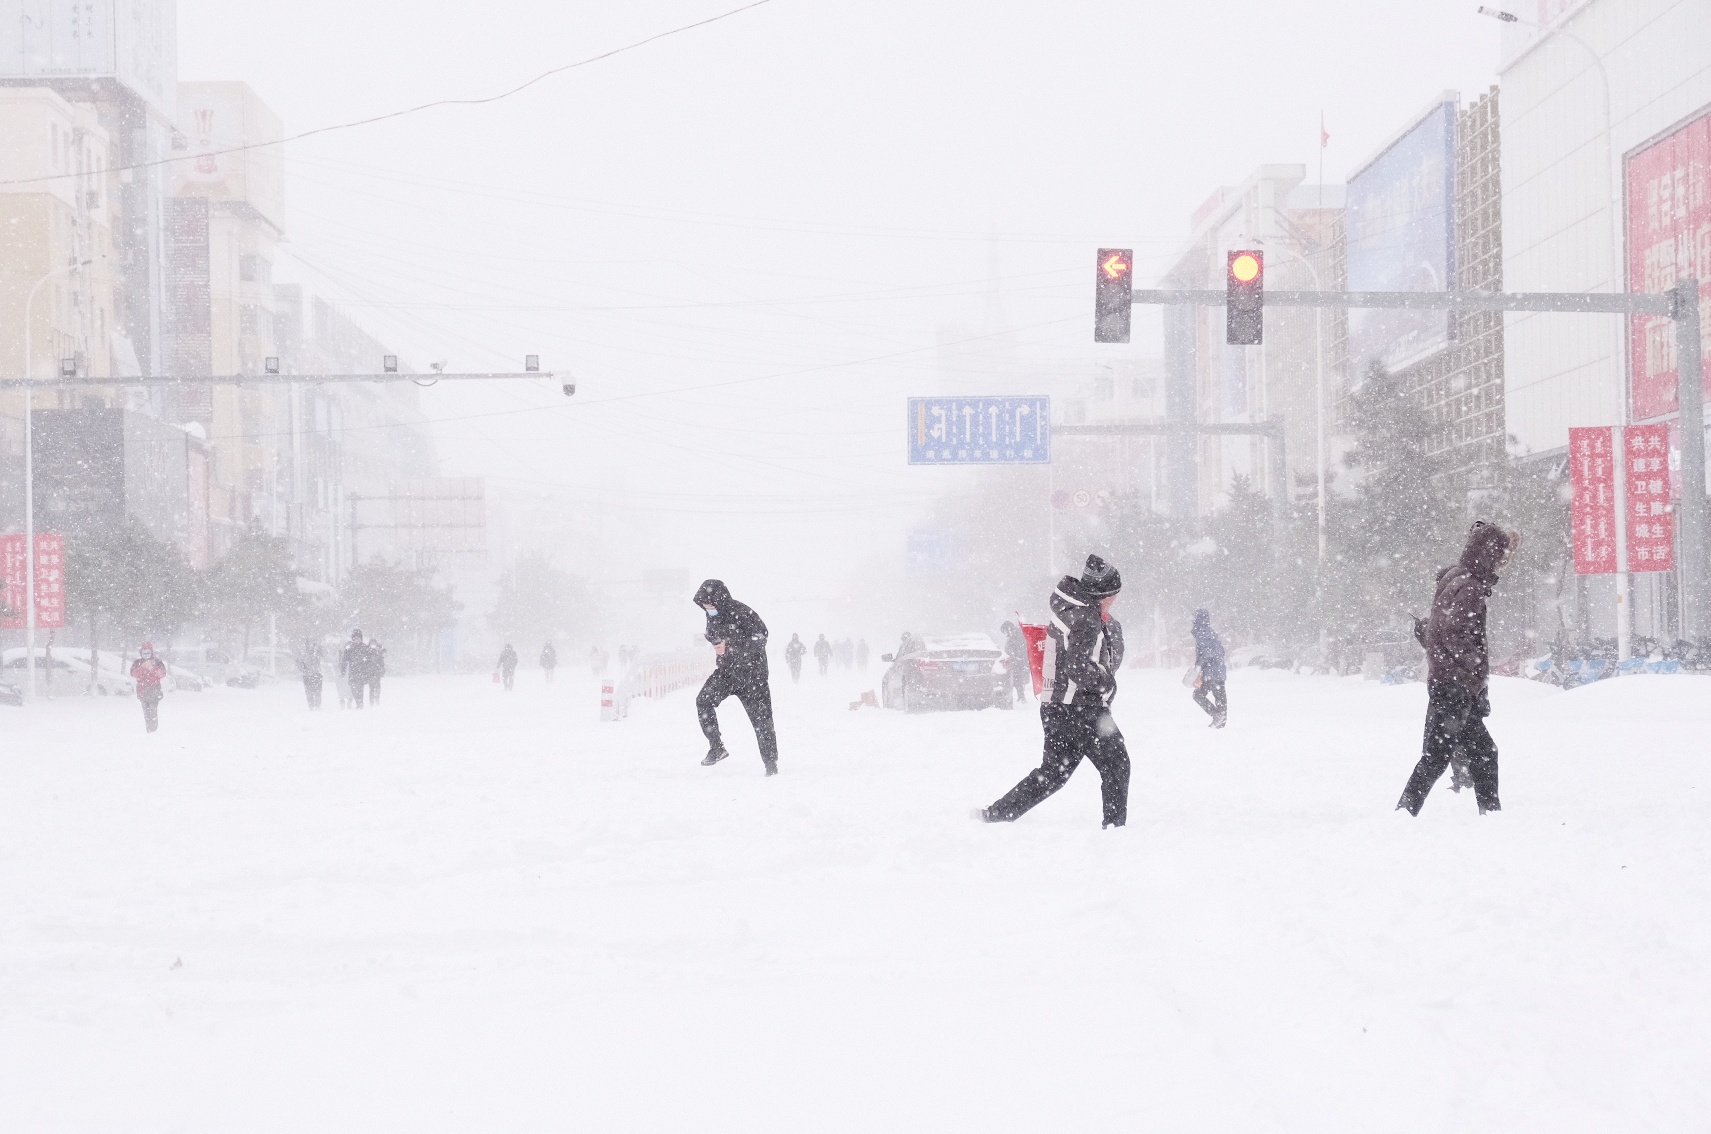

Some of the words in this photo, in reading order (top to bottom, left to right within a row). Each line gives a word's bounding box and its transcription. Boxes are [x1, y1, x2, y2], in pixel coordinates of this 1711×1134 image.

[1631, 435, 1649, 561] 共建卫生城市
[1647, 435, 1668, 560] 共享健康生活
